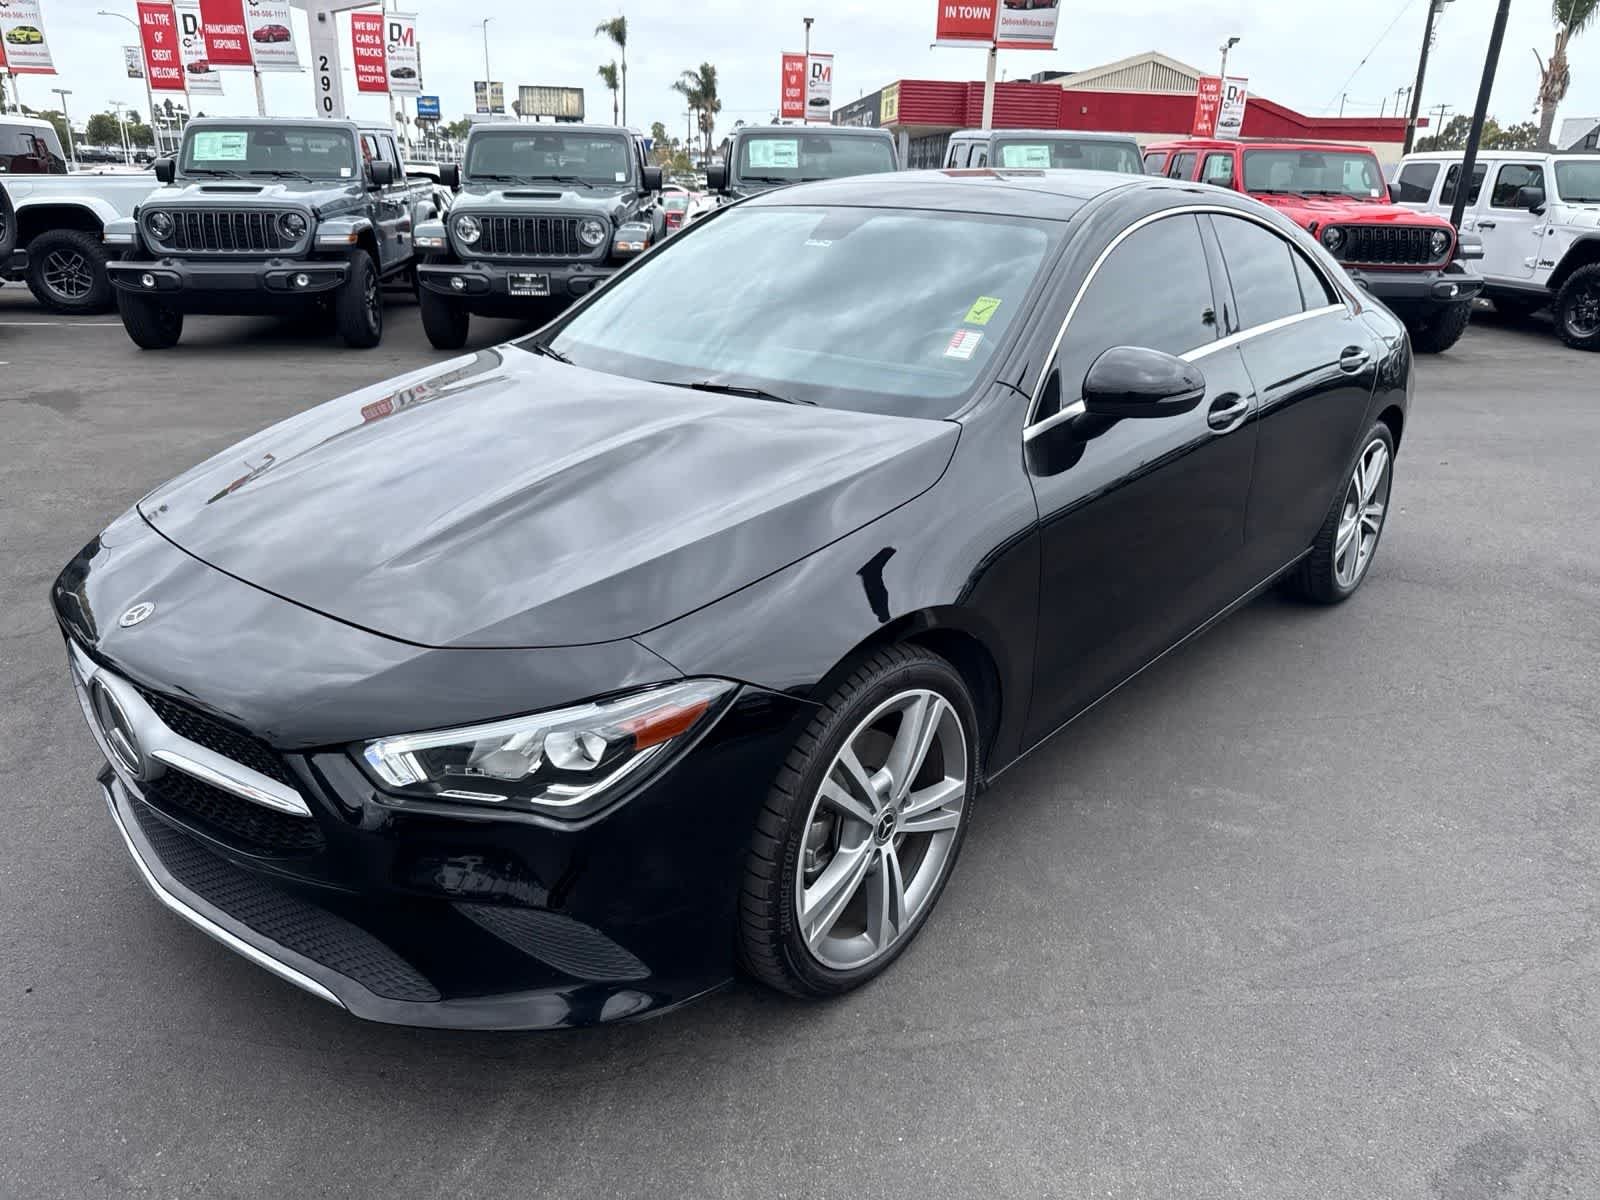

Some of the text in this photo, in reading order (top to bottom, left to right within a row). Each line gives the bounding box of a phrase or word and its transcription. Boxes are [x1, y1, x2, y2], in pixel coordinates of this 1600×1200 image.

[945, 5, 991, 19] IN TOWN
[143, 13, 170, 26] ALL TYPE
[205, 24, 245, 34] FINANCIAMIENTO
[354, 22, 380, 31] WE BUY
[154, 31, 163, 43] OF
[356, 35, 373, 44] CARS
[151, 49, 172, 61] CREDIT
[356, 47, 383, 57] TRUCKS
[150, 67, 180, 79] WELCOME
[358, 64, 383, 73] TRADE-IN
[359, 75, 385, 83] ACCEPTED
[1539, 259, 1555, 267] Jeep
